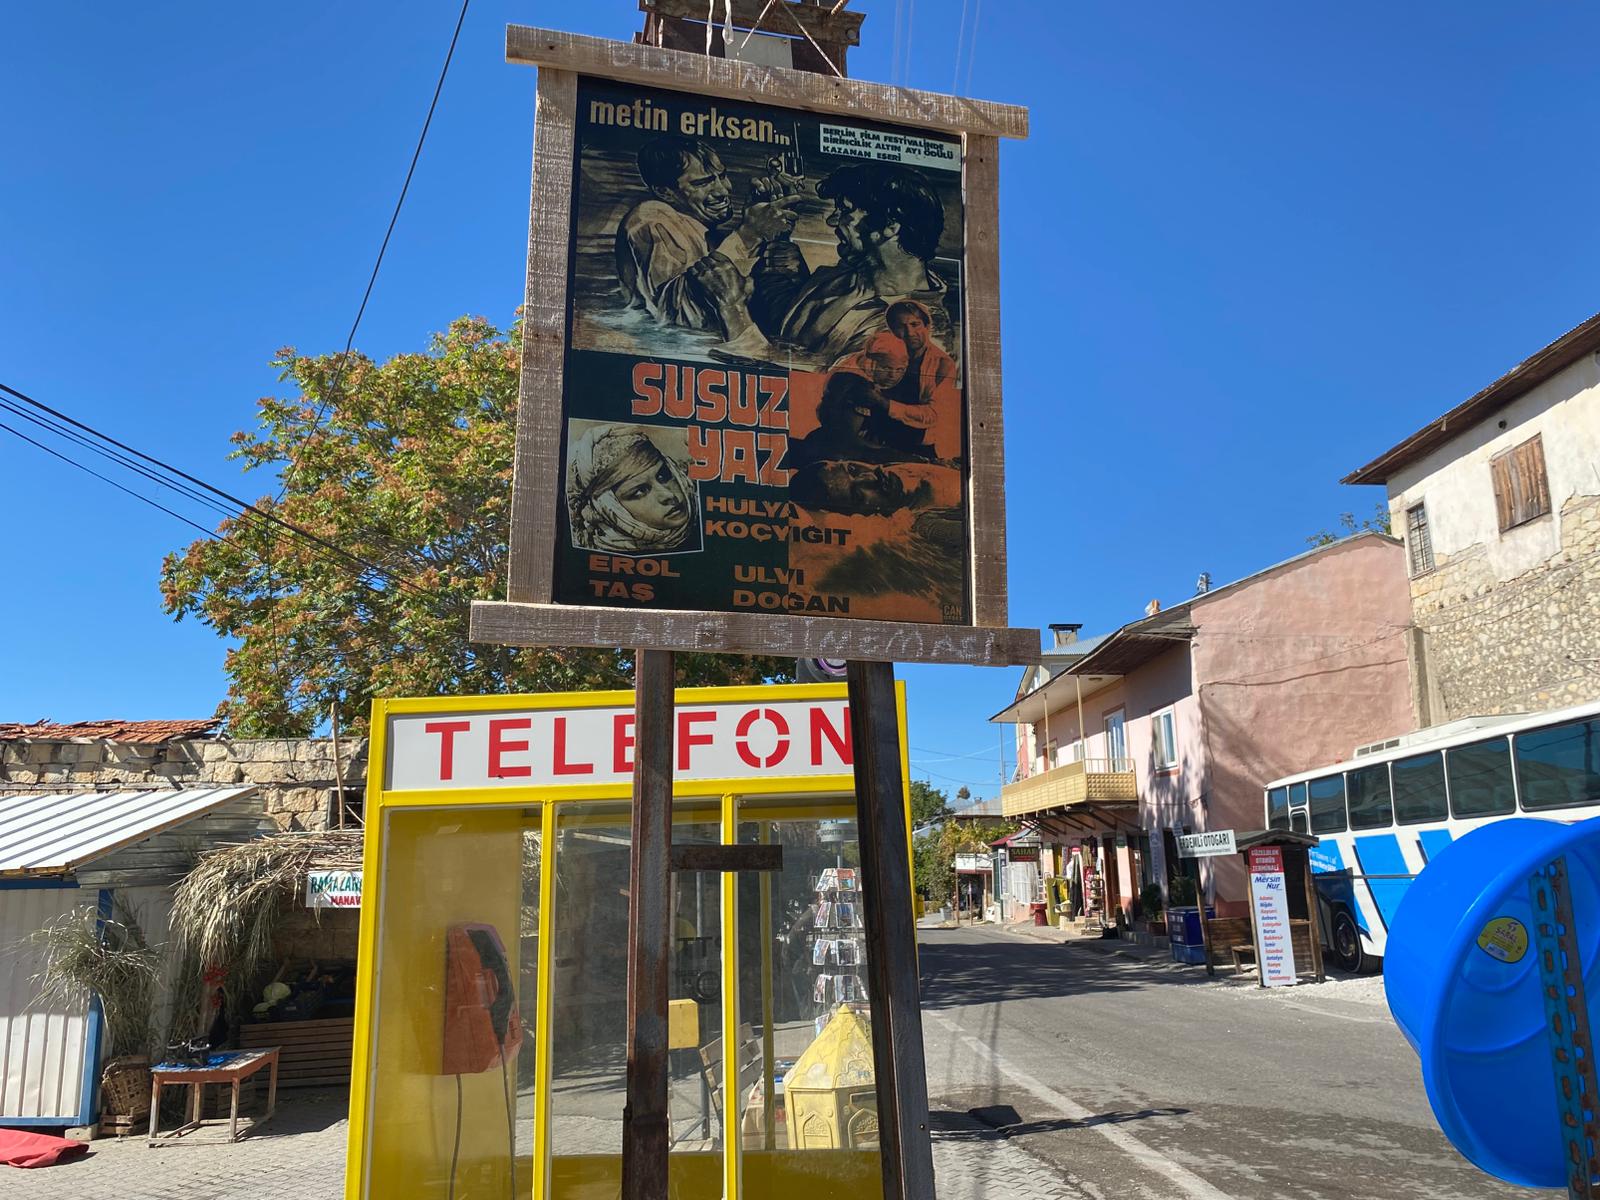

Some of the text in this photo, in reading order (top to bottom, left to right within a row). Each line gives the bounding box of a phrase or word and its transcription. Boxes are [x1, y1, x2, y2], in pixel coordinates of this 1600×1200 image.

[589, 99, 669, 132] metin
[822, 145, 872, 158] KAZANAN
[631, 362, 790, 430] SUSUZ
[687, 425, 790, 487] YAZ
[706, 496, 800, 519] HULYA
[589, 554, 681, 578] EROL
[425, 707, 854, 780] TELEFON
[310, 876, 362, 894] RAMAZAN
[1254, 876, 1281, 884] Mersin
